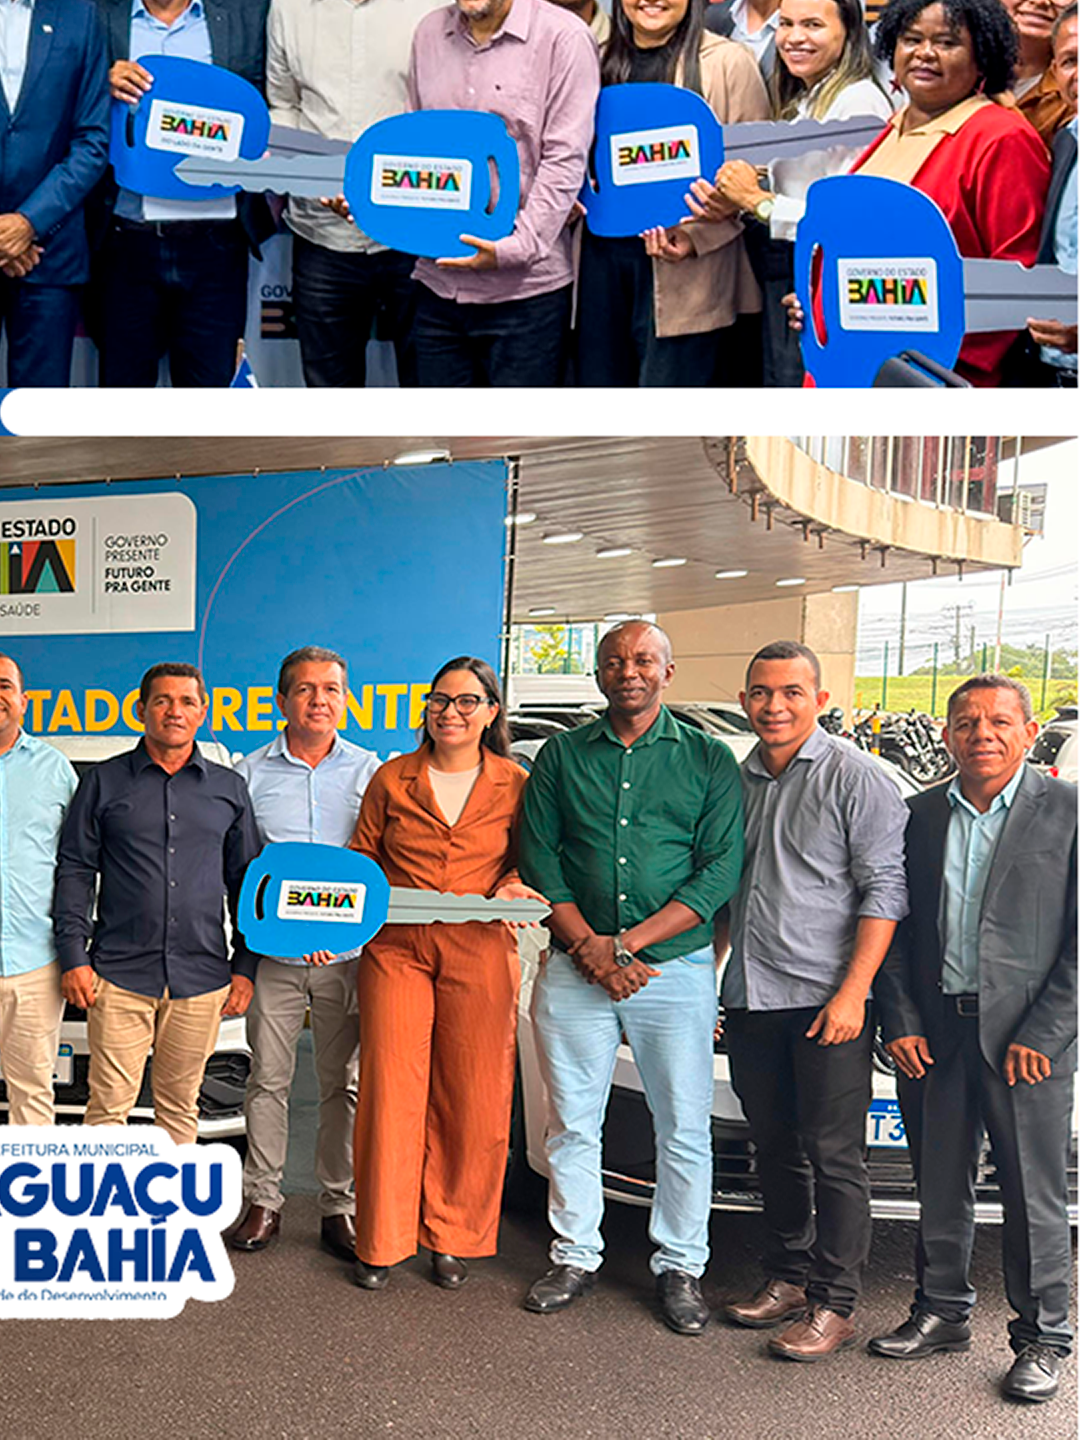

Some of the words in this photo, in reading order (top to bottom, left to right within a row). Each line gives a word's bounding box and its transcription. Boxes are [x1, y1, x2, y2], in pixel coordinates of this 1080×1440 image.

[1, 517, 77, 538] ESTADO
[104, 533, 168, 549] GOVERNO
[104, 547, 161, 562] PRESENTE
[104, 566, 155, 580] FUTURO
[104, 579, 127, 594] PRA
[129, 578, 171, 592] GENTE
[0, 600, 41, 618] SAÚDE
[19, 688, 147, 734] TADO
